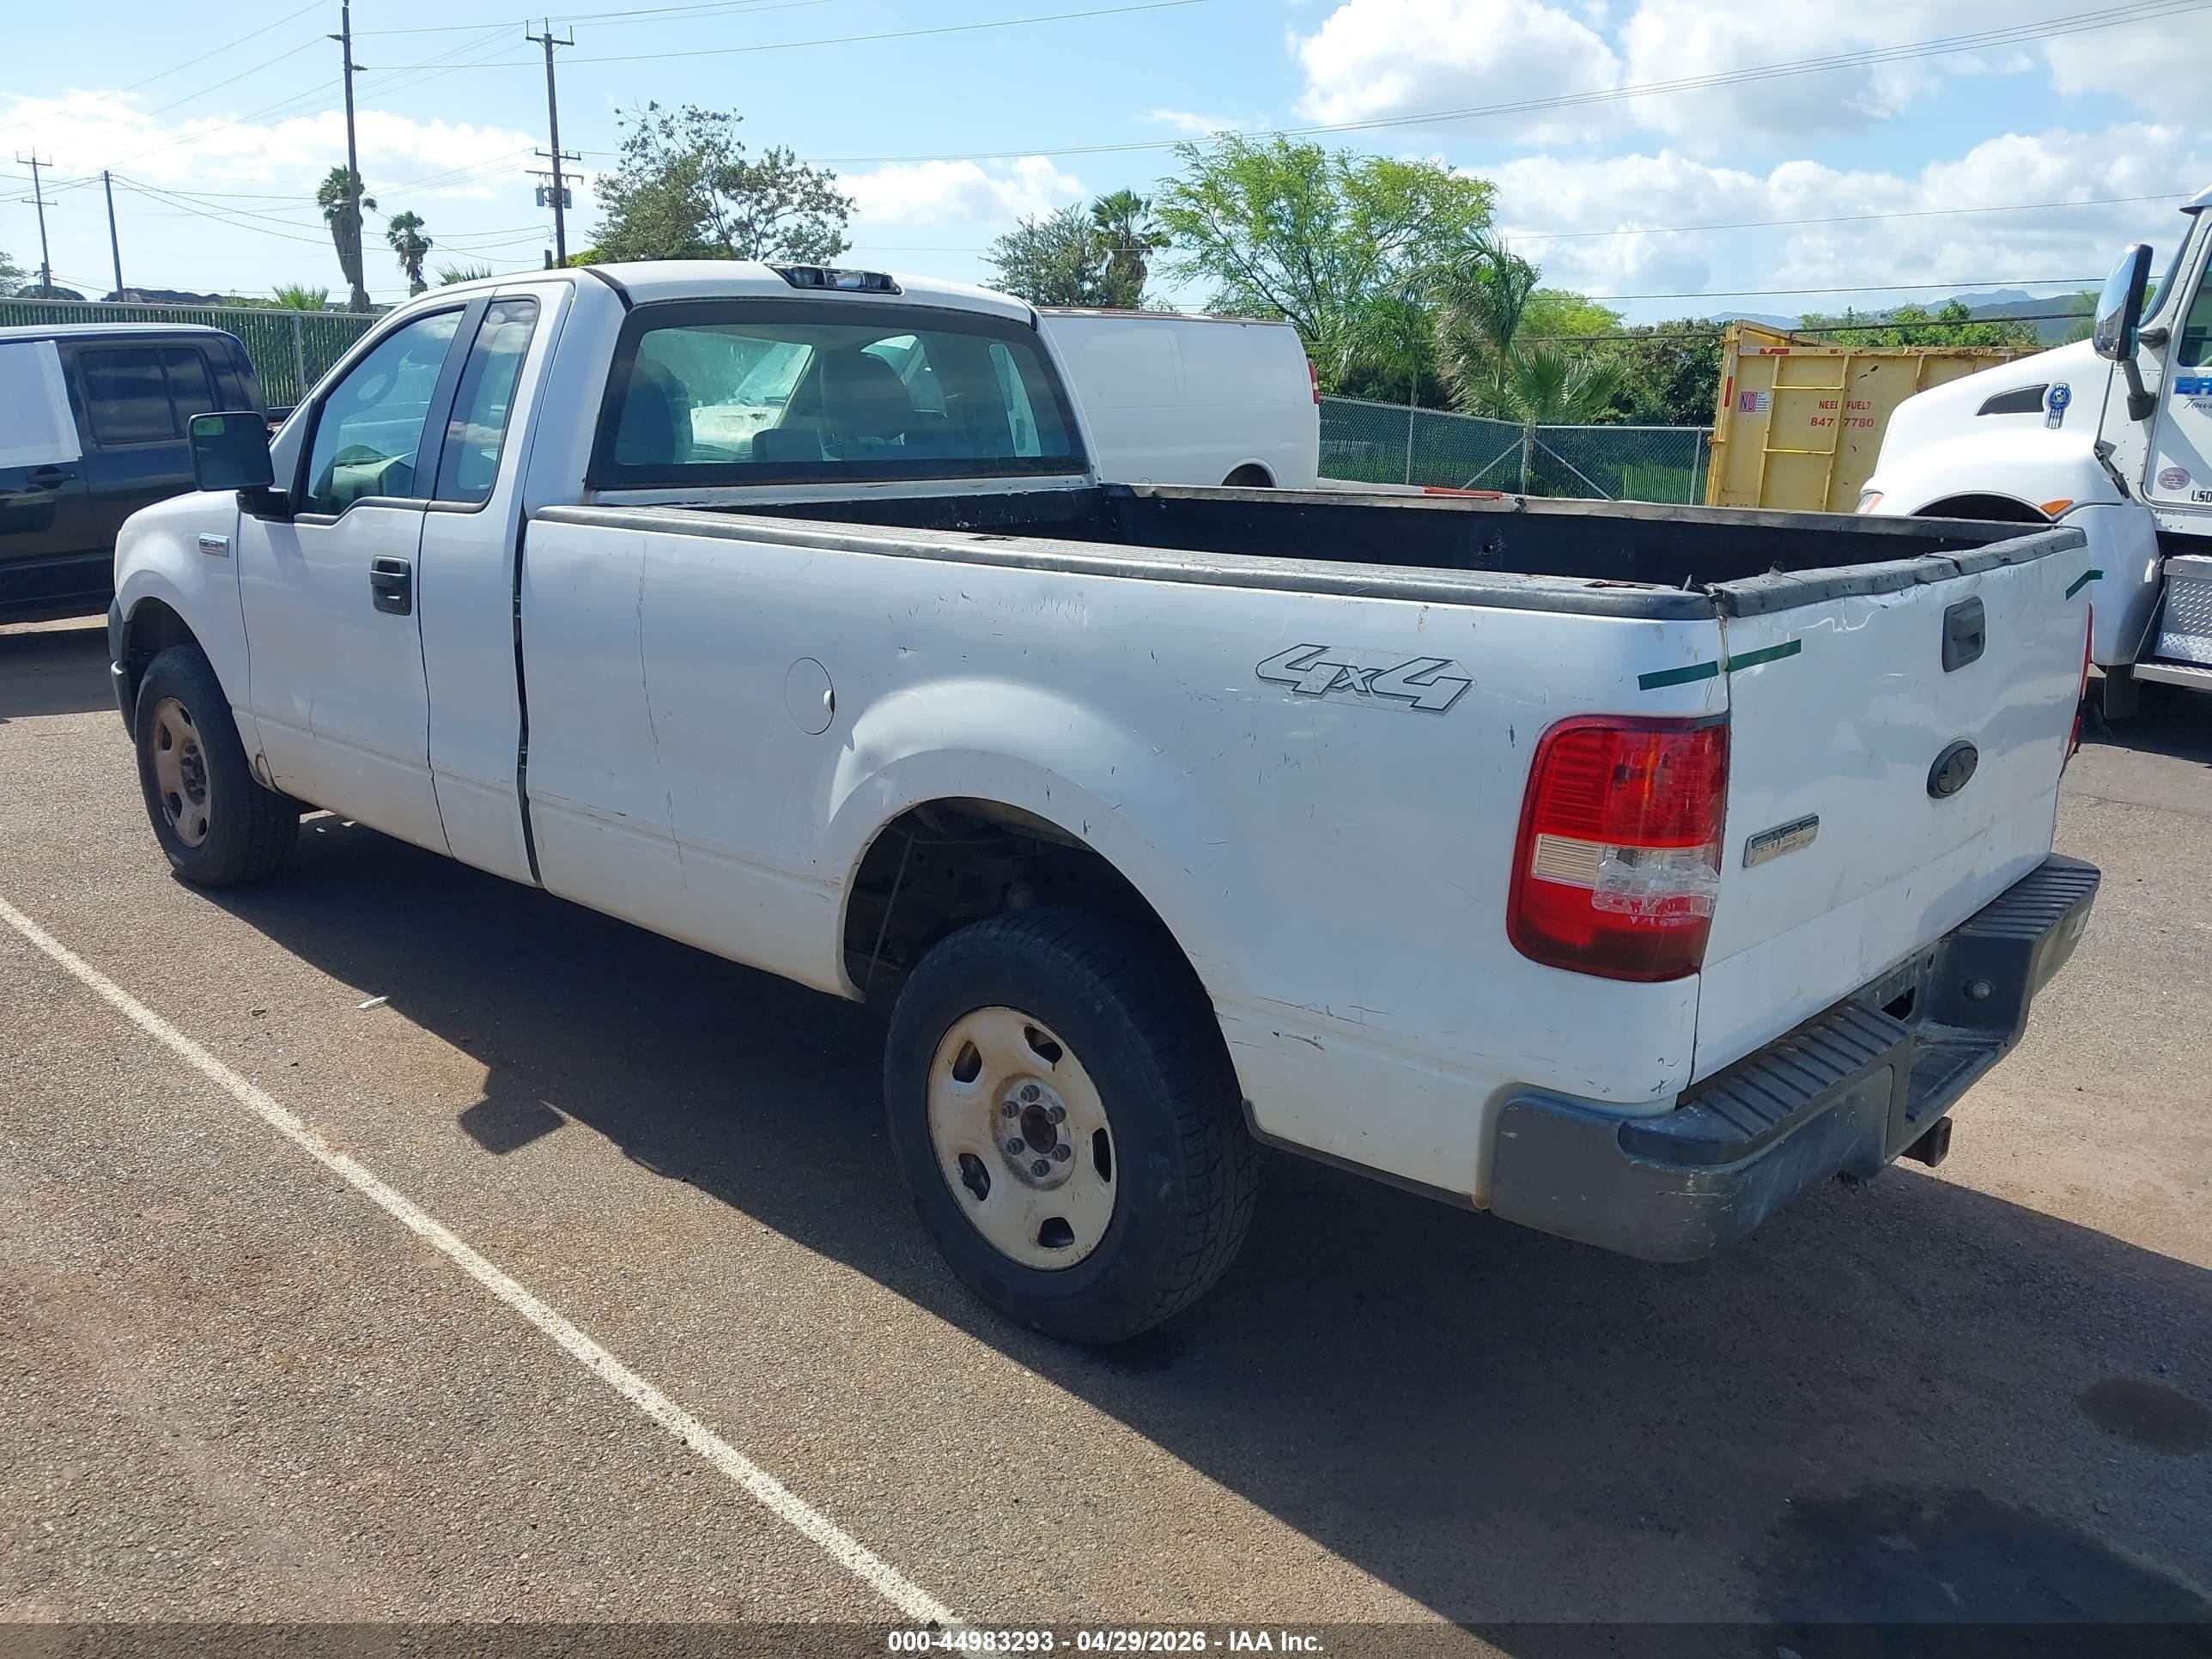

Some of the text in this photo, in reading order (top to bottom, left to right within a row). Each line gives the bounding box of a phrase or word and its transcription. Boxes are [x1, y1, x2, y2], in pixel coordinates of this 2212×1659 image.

[1740, 392, 1757, 411] NO
[1846, 401, 1871, 410] FUEL?
[1844, 417, 1875, 428] 7780
[1255, 643, 1474, 715] 4x4
